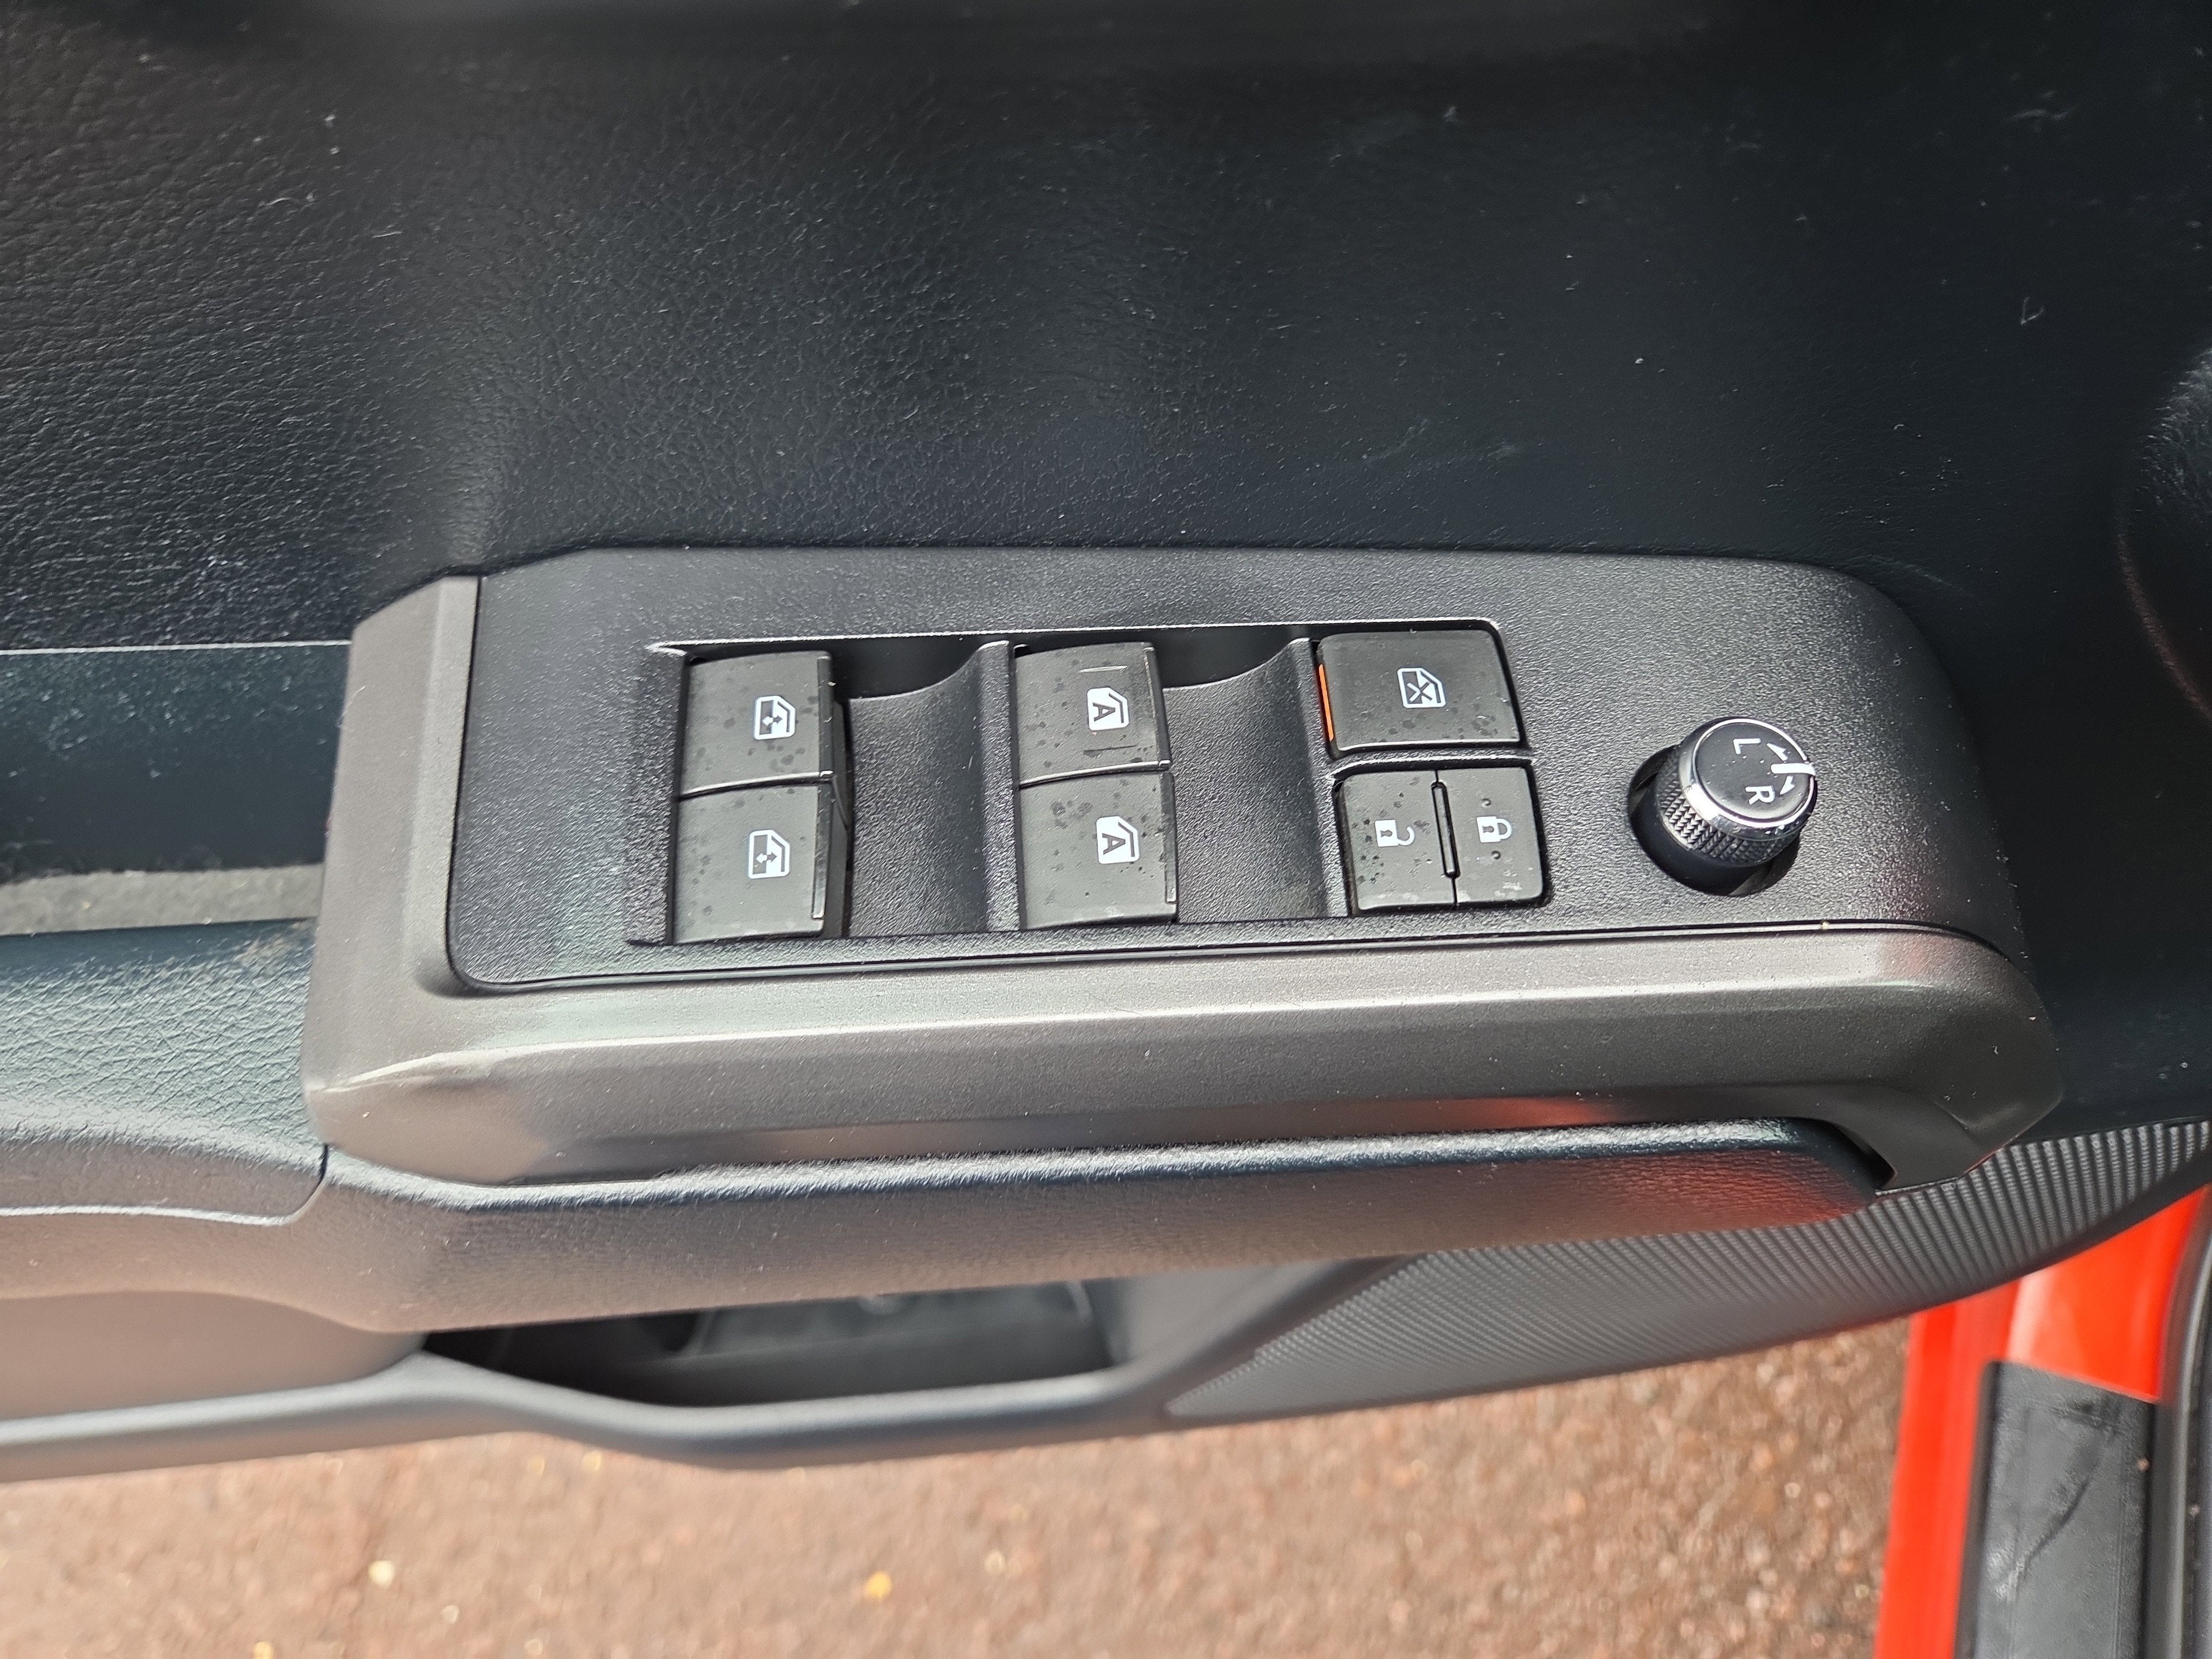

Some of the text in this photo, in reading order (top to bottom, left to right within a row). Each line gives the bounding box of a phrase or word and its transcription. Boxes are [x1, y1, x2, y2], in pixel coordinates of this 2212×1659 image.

[1092, 702, 1116, 722] A
[1733, 738, 1761, 754] L
[1745, 786, 1775, 805] R
[1102, 833, 1126, 855] A
